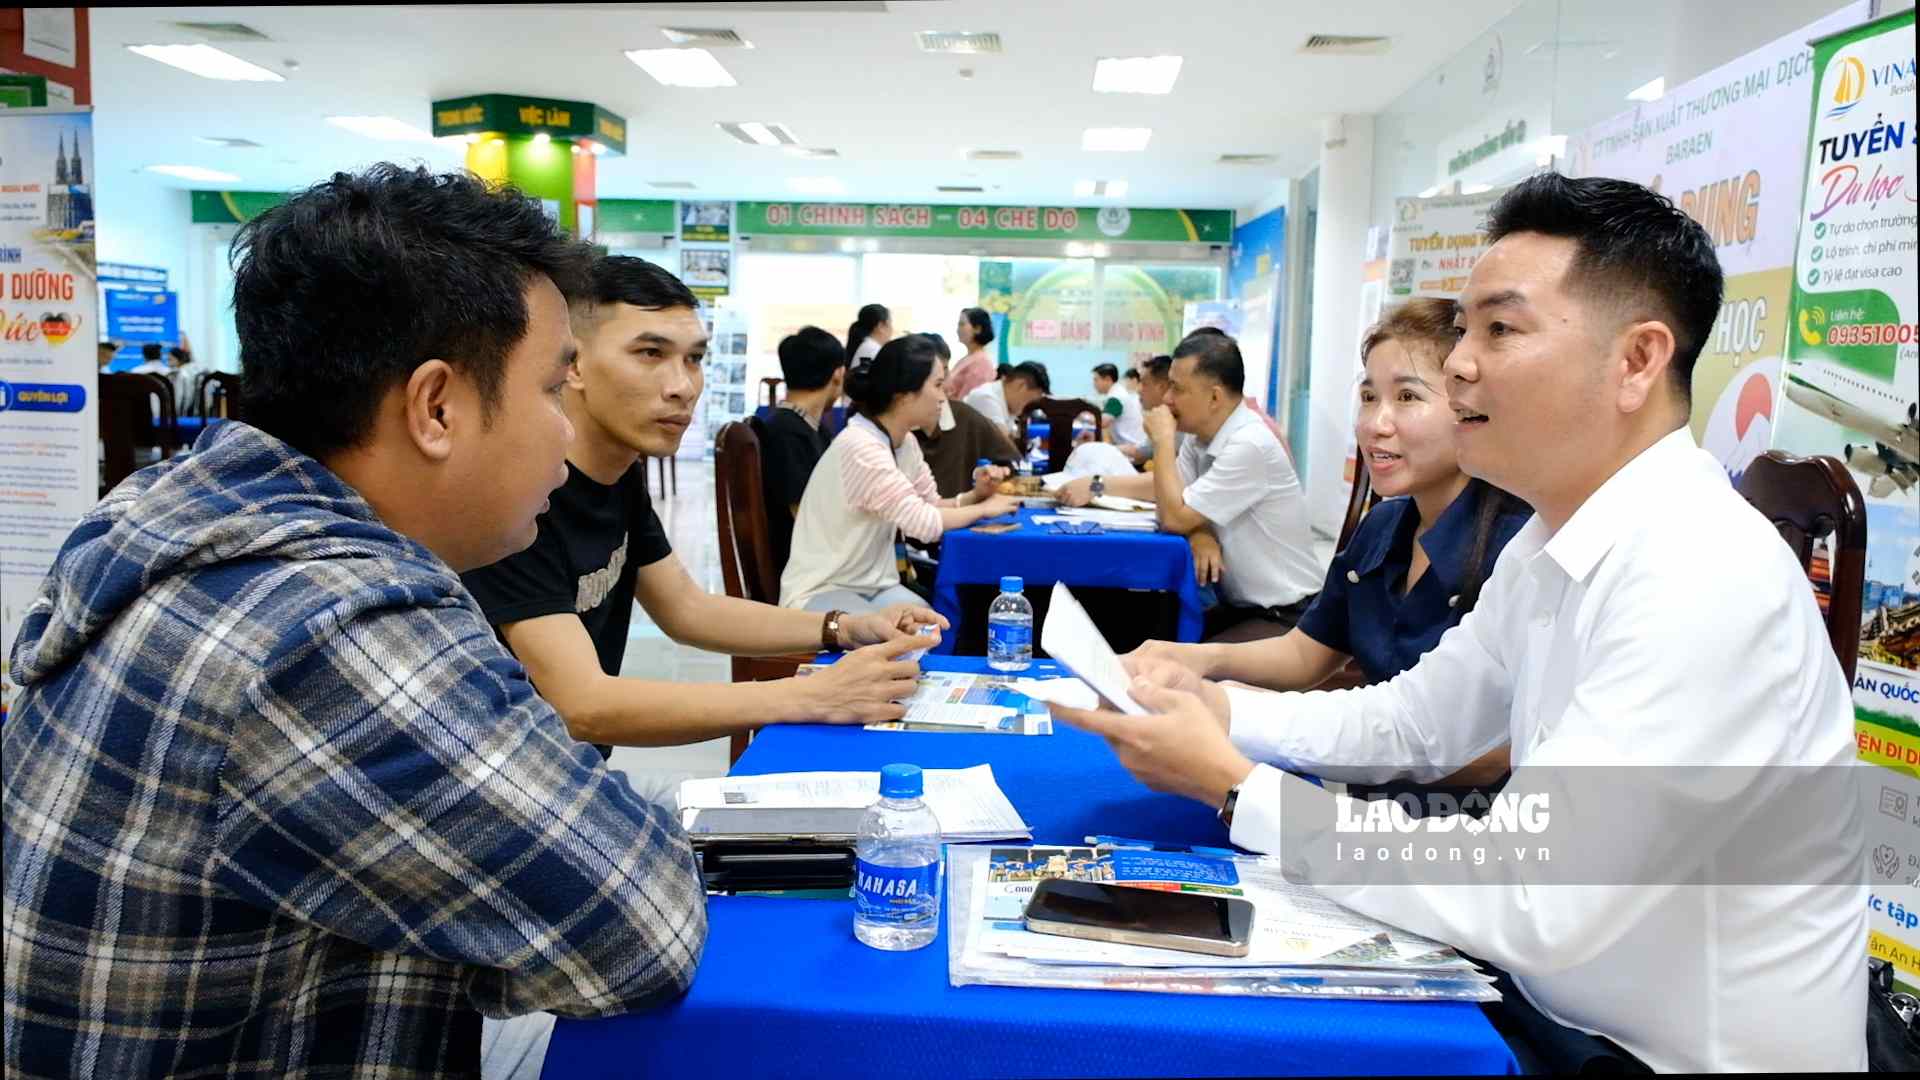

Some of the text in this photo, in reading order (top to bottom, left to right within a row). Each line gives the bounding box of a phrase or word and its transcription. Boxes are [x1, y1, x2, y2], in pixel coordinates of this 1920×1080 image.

[1666, 131, 1713, 165] BARAEN
[1819, 113, 1905, 165] TUYỂN
[958, 207, 988, 229] 04
[11, 268, 74, 300] DƯỠNG
[1880, 266, 1903, 278] cao
[1856, 730, 1882, 754] ỆN
[1887, 900, 1918, 929] tập
